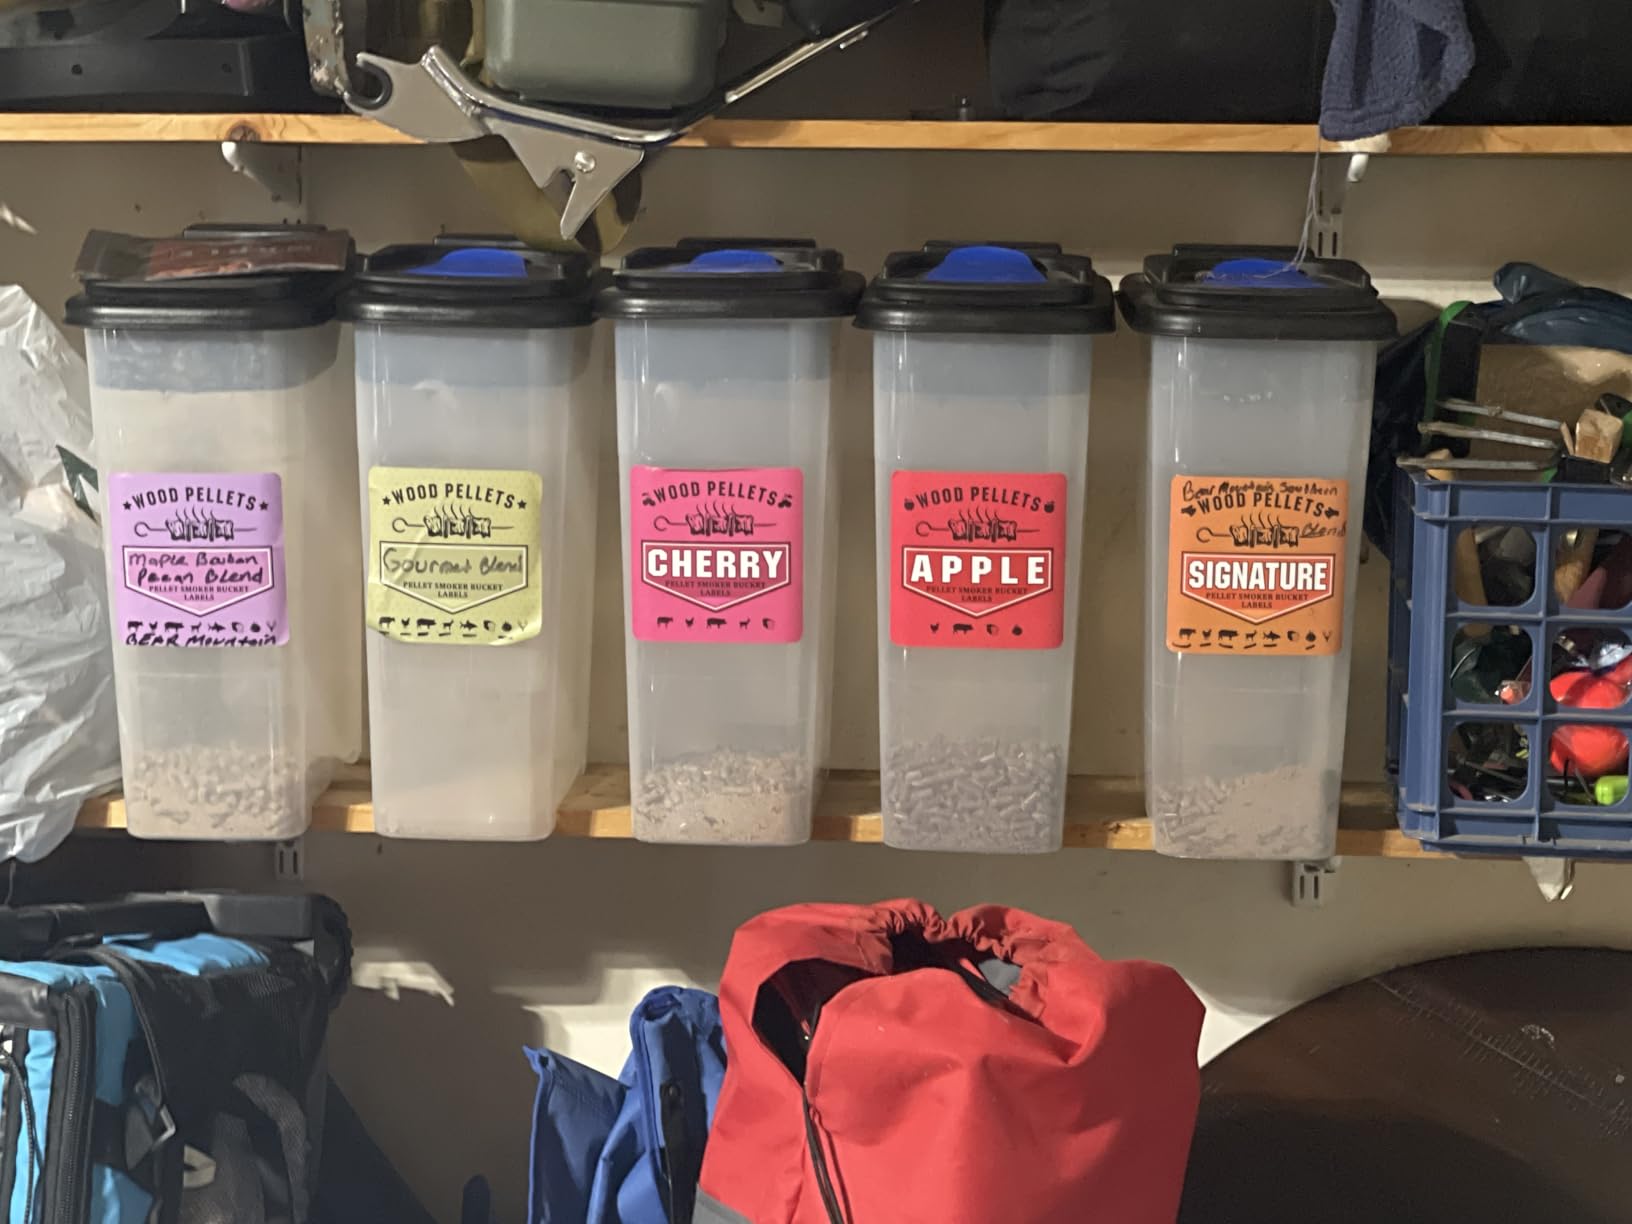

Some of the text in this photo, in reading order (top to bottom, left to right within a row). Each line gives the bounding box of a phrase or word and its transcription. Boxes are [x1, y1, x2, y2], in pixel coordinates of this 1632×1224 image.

[132, 487, 256, 511] WOOD PELLETS
[391, 483, 515, 509] WOOD PELLETS
[654, 481, 777, 506] WOOD PELLETS
[916, 486, 1041, 512] WOOD PELLETS
[1197, 492, 1325, 518] WOOD PELLETS
[383, 547, 472, 574] Gourmet
[648, 549, 783, 578] CHERRY
[911, 554, 1045, 585] APPLE
[205, 567, 263, 584] Blend
[665, 580, 695, 588] PELLET
[1188, 560, 1328, 591] SIGNATURE
[995, 587, 1028, 595] BUCKET
[1206, 592, 1237, 600] PELLET
[1275, 593, 1308, 601] BUCKET
[1241, 601, 1273, 609] LABELS
[126, 633, 179, 646] BEAR
